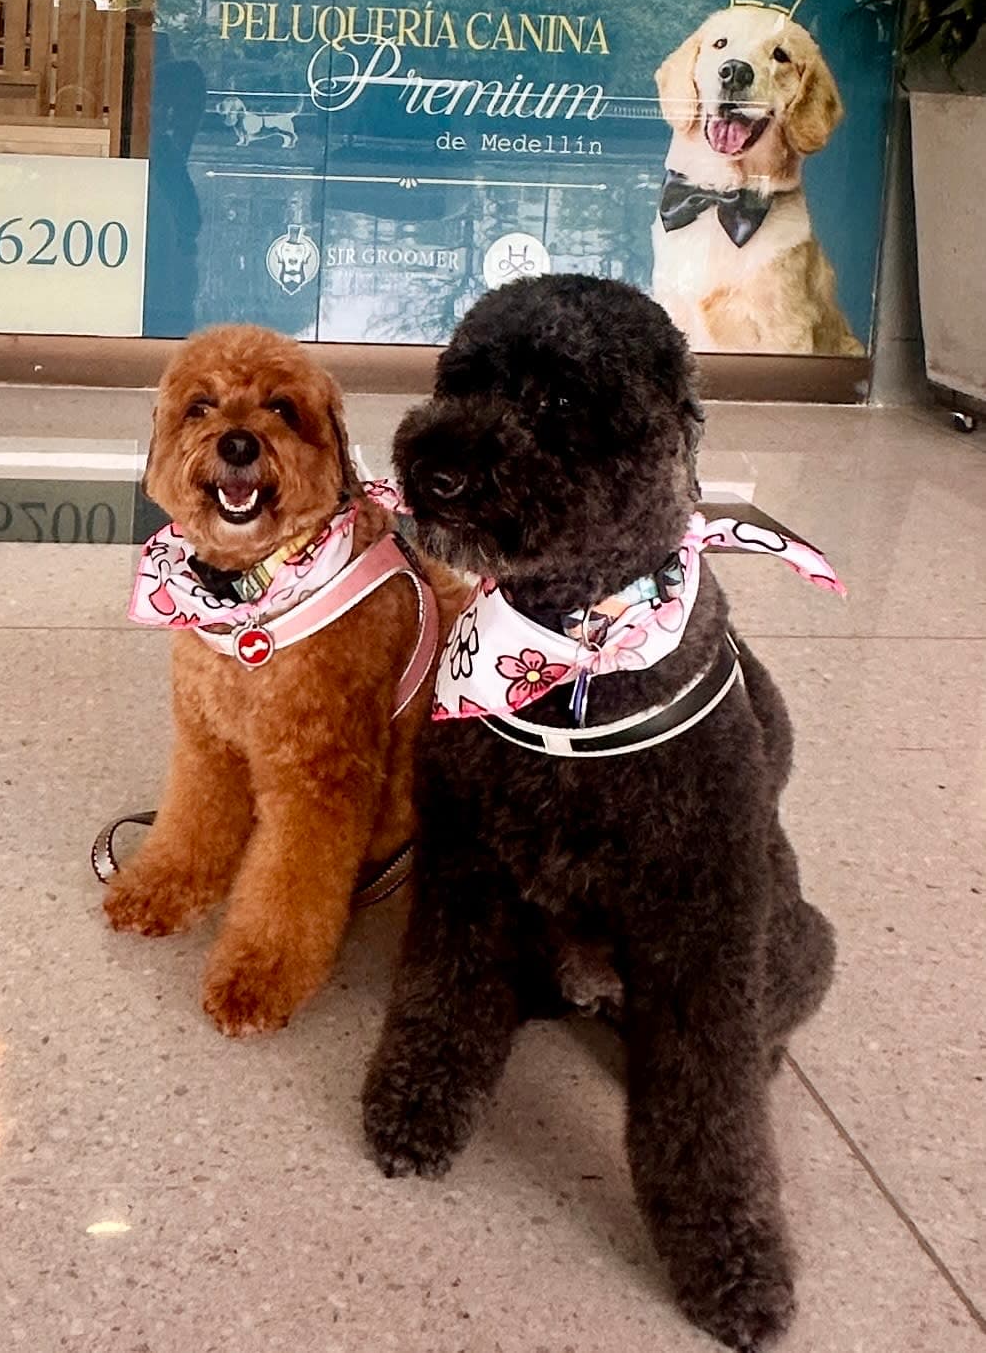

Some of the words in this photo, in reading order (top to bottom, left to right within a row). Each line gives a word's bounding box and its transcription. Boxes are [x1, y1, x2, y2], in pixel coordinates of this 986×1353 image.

[218, 0, 459, 52] PELUQUERÍA
[465, 10, 611, 55] CANINA
[306, 31, 611, 121] Premium
[435, 131, 468, 151] de
[481, 132, 604, 155] Medellín
[326, 246, 356, 266] SIR
[361, 248, 459, 269] GROOMER
